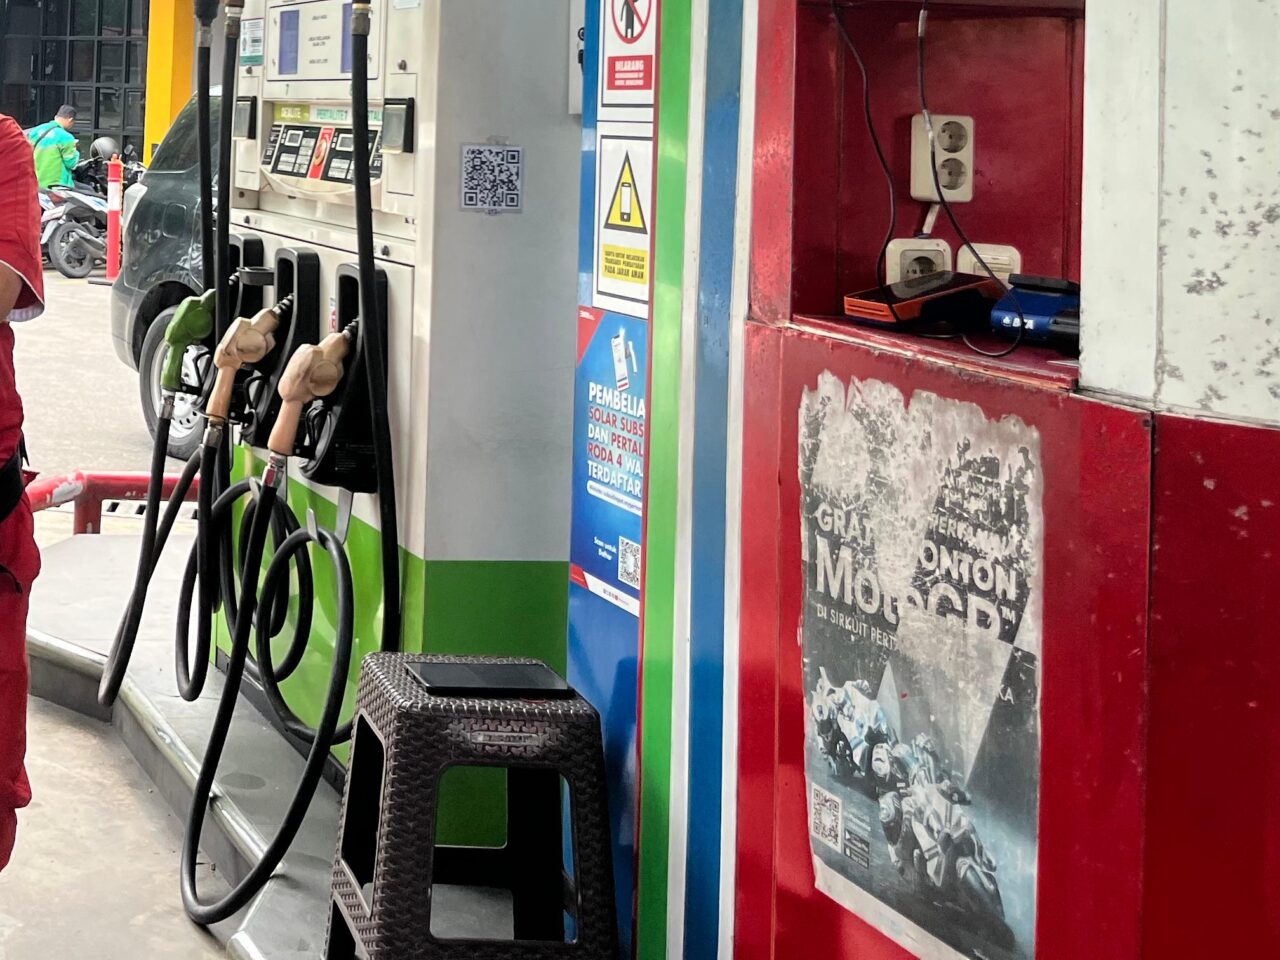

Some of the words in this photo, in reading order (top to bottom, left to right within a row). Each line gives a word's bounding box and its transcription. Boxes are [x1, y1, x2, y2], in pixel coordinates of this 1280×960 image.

[615, 60, 644, 72] DILARANG
[588, 381, 646, 420] PEMBELIA
[588, 405, 618, 430] SOLAR
[620, 416, 644, 438] SUBS
[588, 423, 609, 444] DAN
[610, 432, 644, 457] PERTAL
[587, 442, 614, 466] RODA
[616, 453, 623, 469] 4
[625, 454, 644, 477] WA
[587, 460, 642, 498] TERDAFTAR
[830, 608, 868, 639] SIRKUIT
